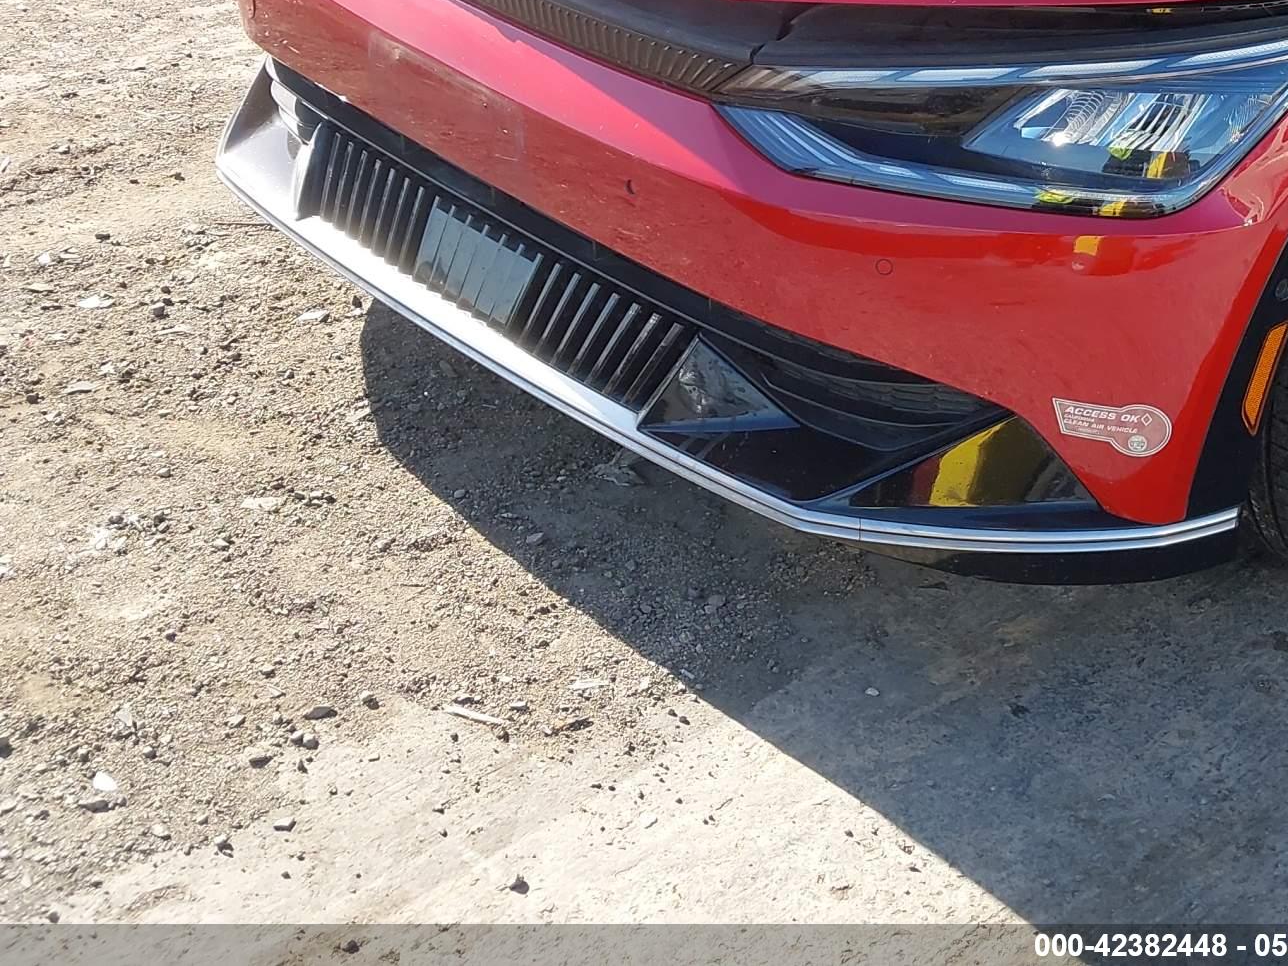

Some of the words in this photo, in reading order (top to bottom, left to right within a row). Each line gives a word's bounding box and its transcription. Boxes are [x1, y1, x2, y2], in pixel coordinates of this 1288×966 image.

[1064, 406, 1117, 420] ACCESS
[1120, 414, 1141, 424] OK
[1063, 418, 1090, 427] CLEAN
[1090, 423, 1105, 431] AIR
[1106, 425, 1139, 434] VEHICLE
